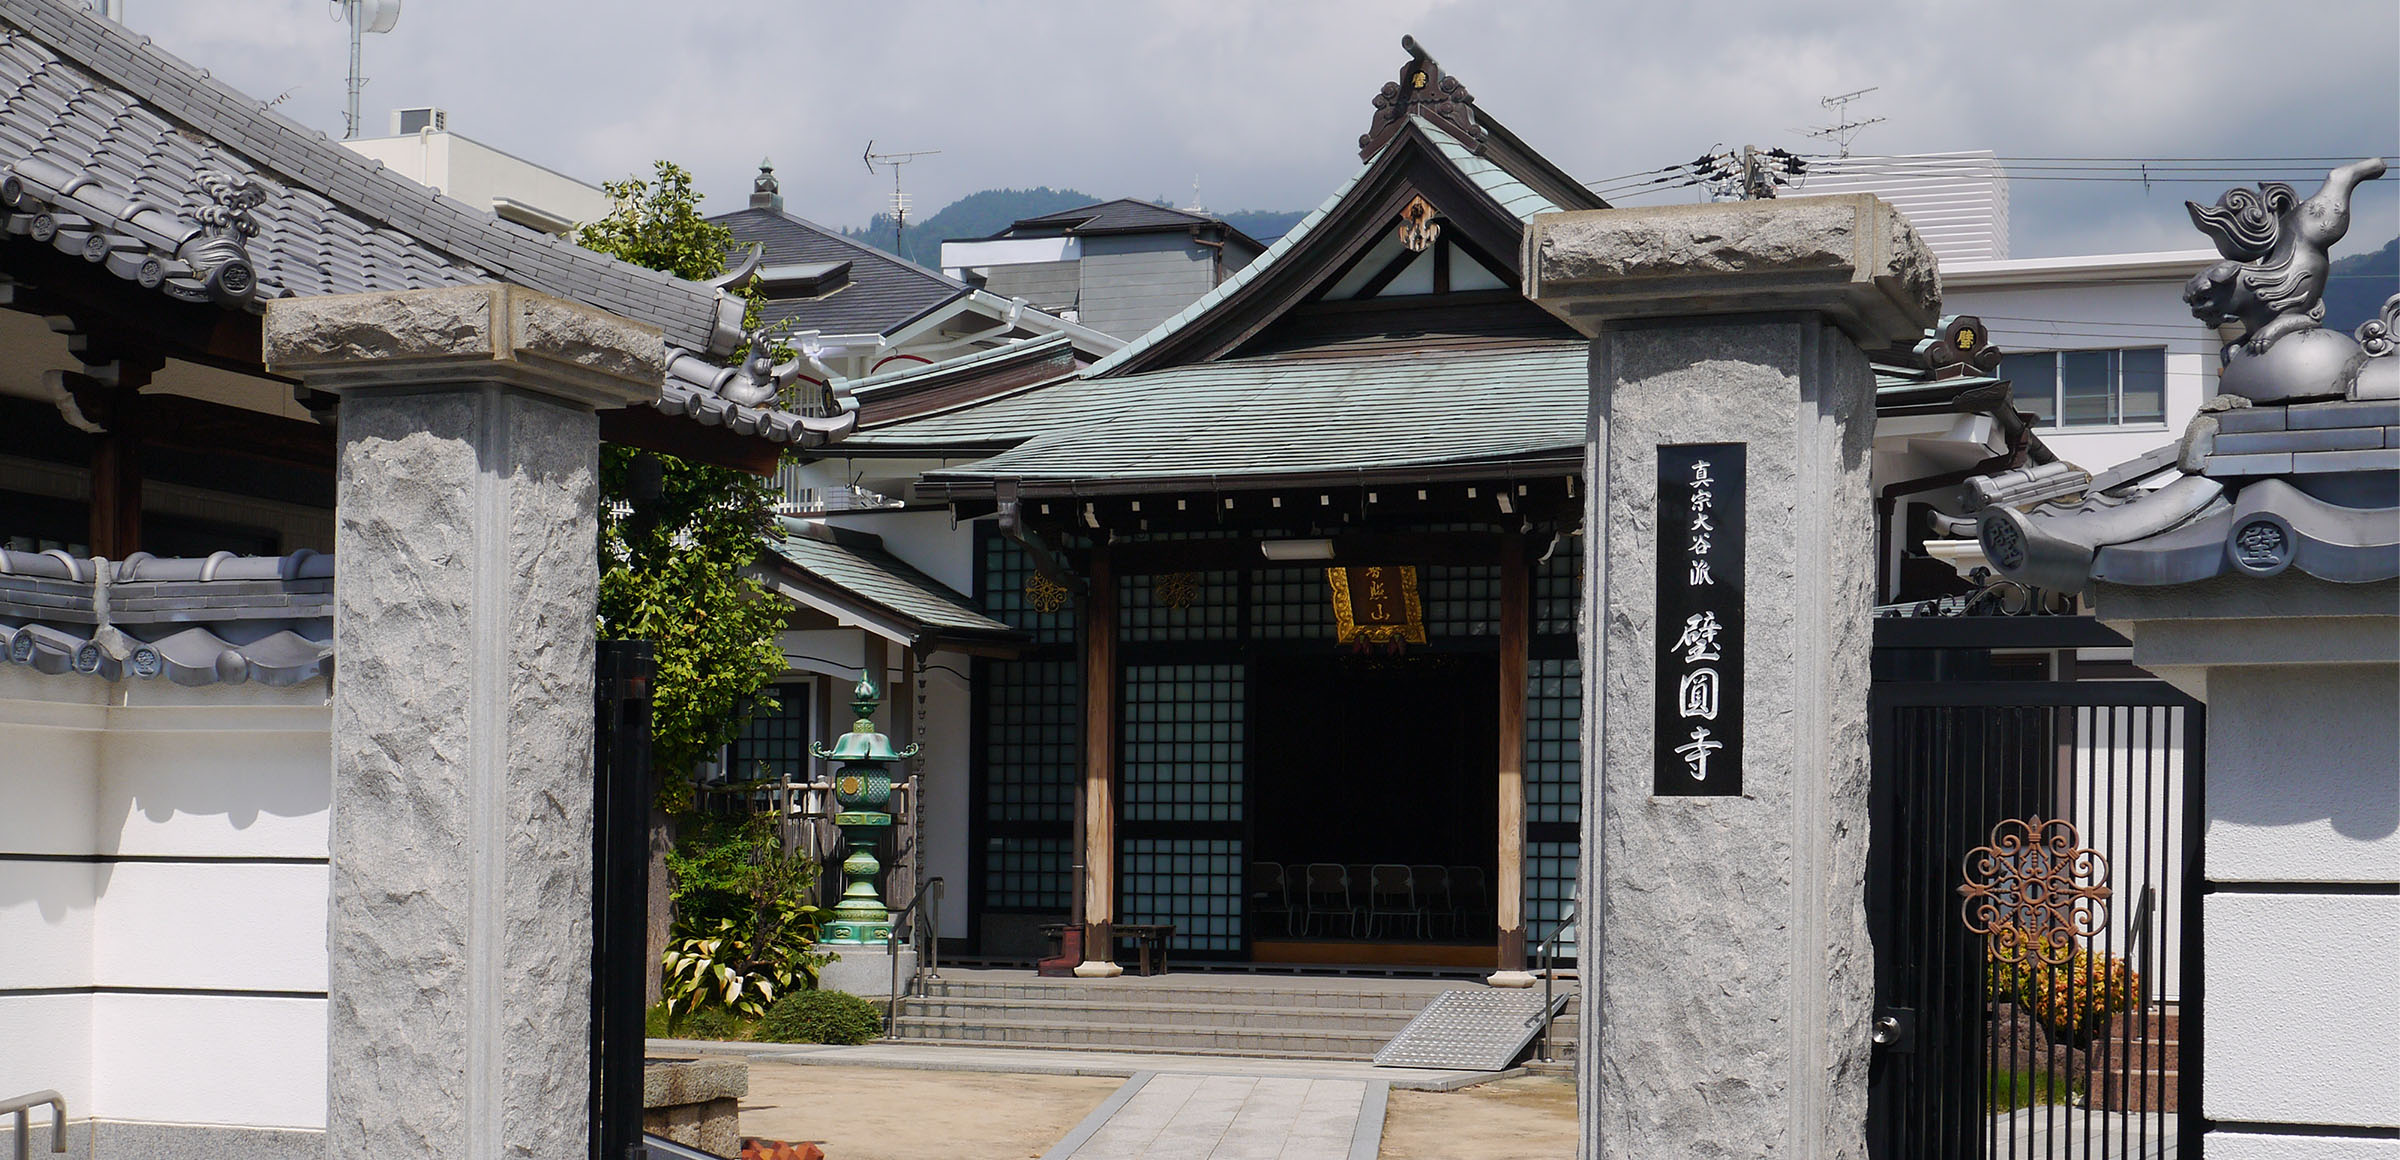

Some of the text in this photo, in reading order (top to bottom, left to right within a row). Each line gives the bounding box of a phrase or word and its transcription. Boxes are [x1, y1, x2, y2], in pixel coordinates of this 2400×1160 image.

[1670, 459, 1723, 782] 真宗大谷派 璧圓寺
